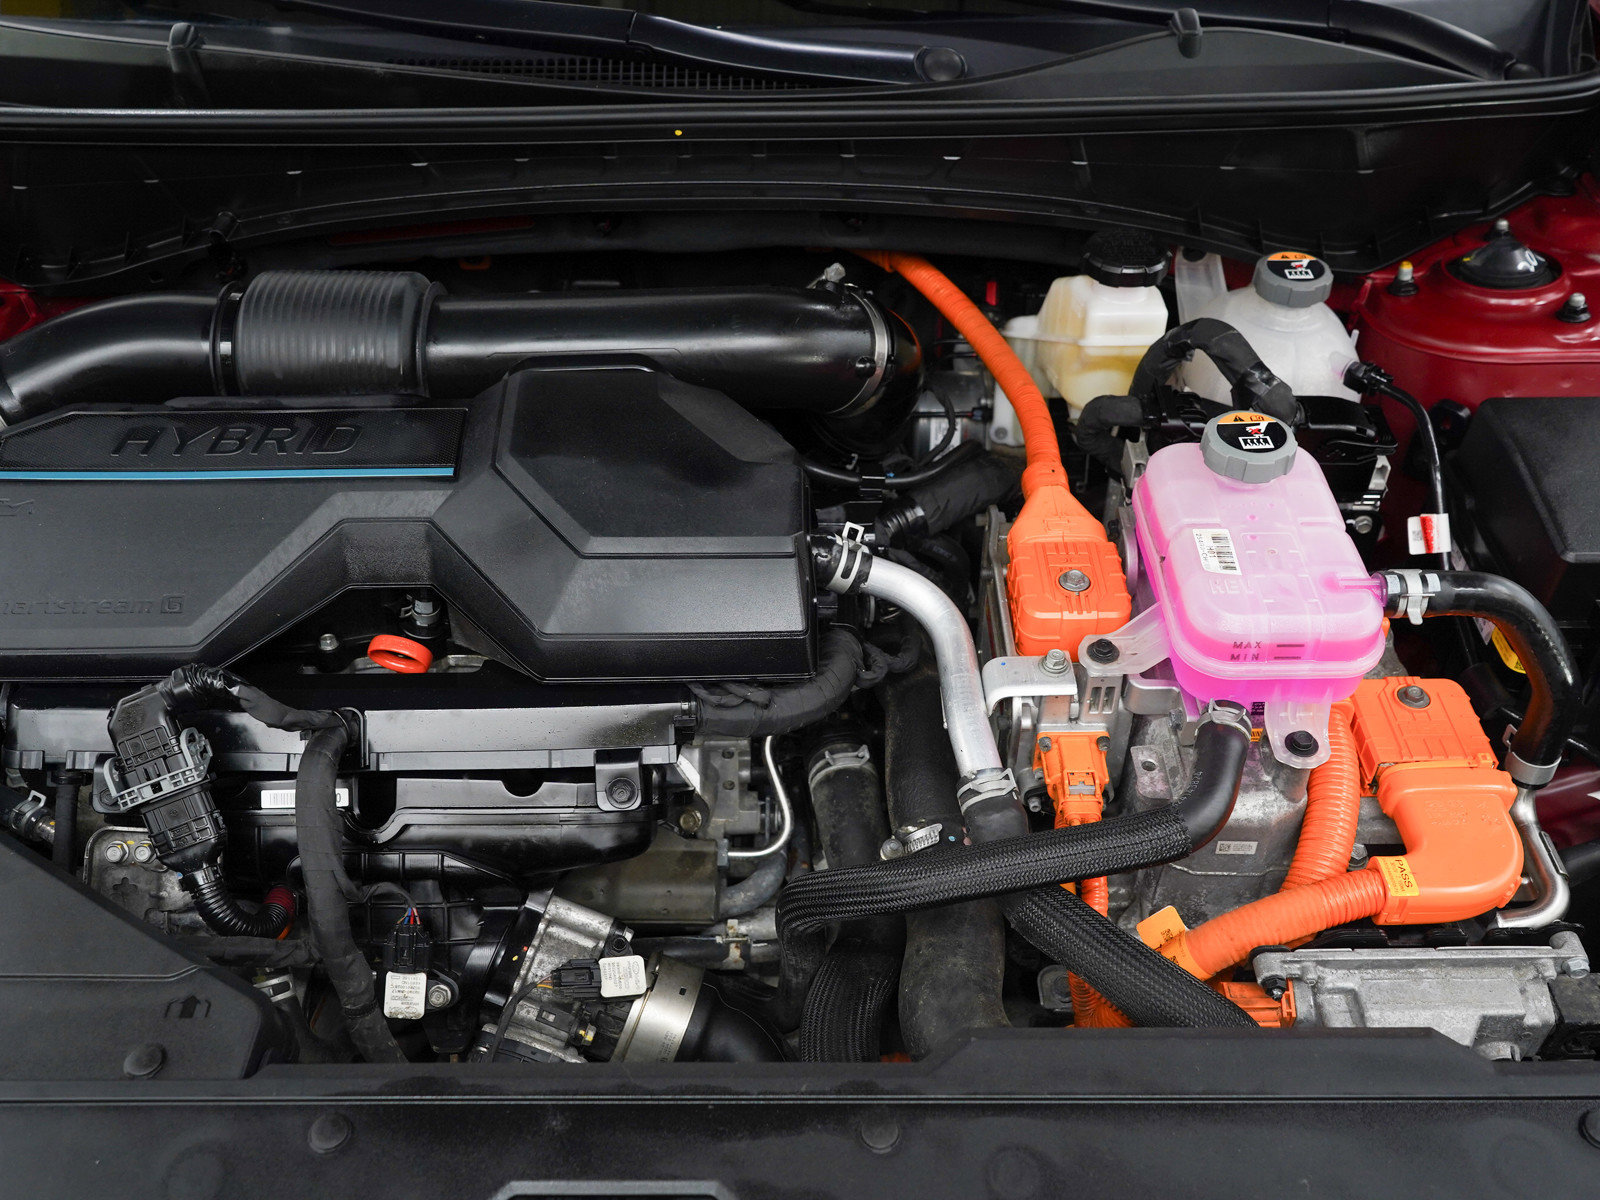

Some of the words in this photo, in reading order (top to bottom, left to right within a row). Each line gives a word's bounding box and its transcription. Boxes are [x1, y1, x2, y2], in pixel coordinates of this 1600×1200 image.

[110, 426, 364, 457] HYBRID
[1232, 641, 1263, 649] MAX
[1229, 653, 1260, 661] MIN
[1394, 859, 1413, 888] PASS
